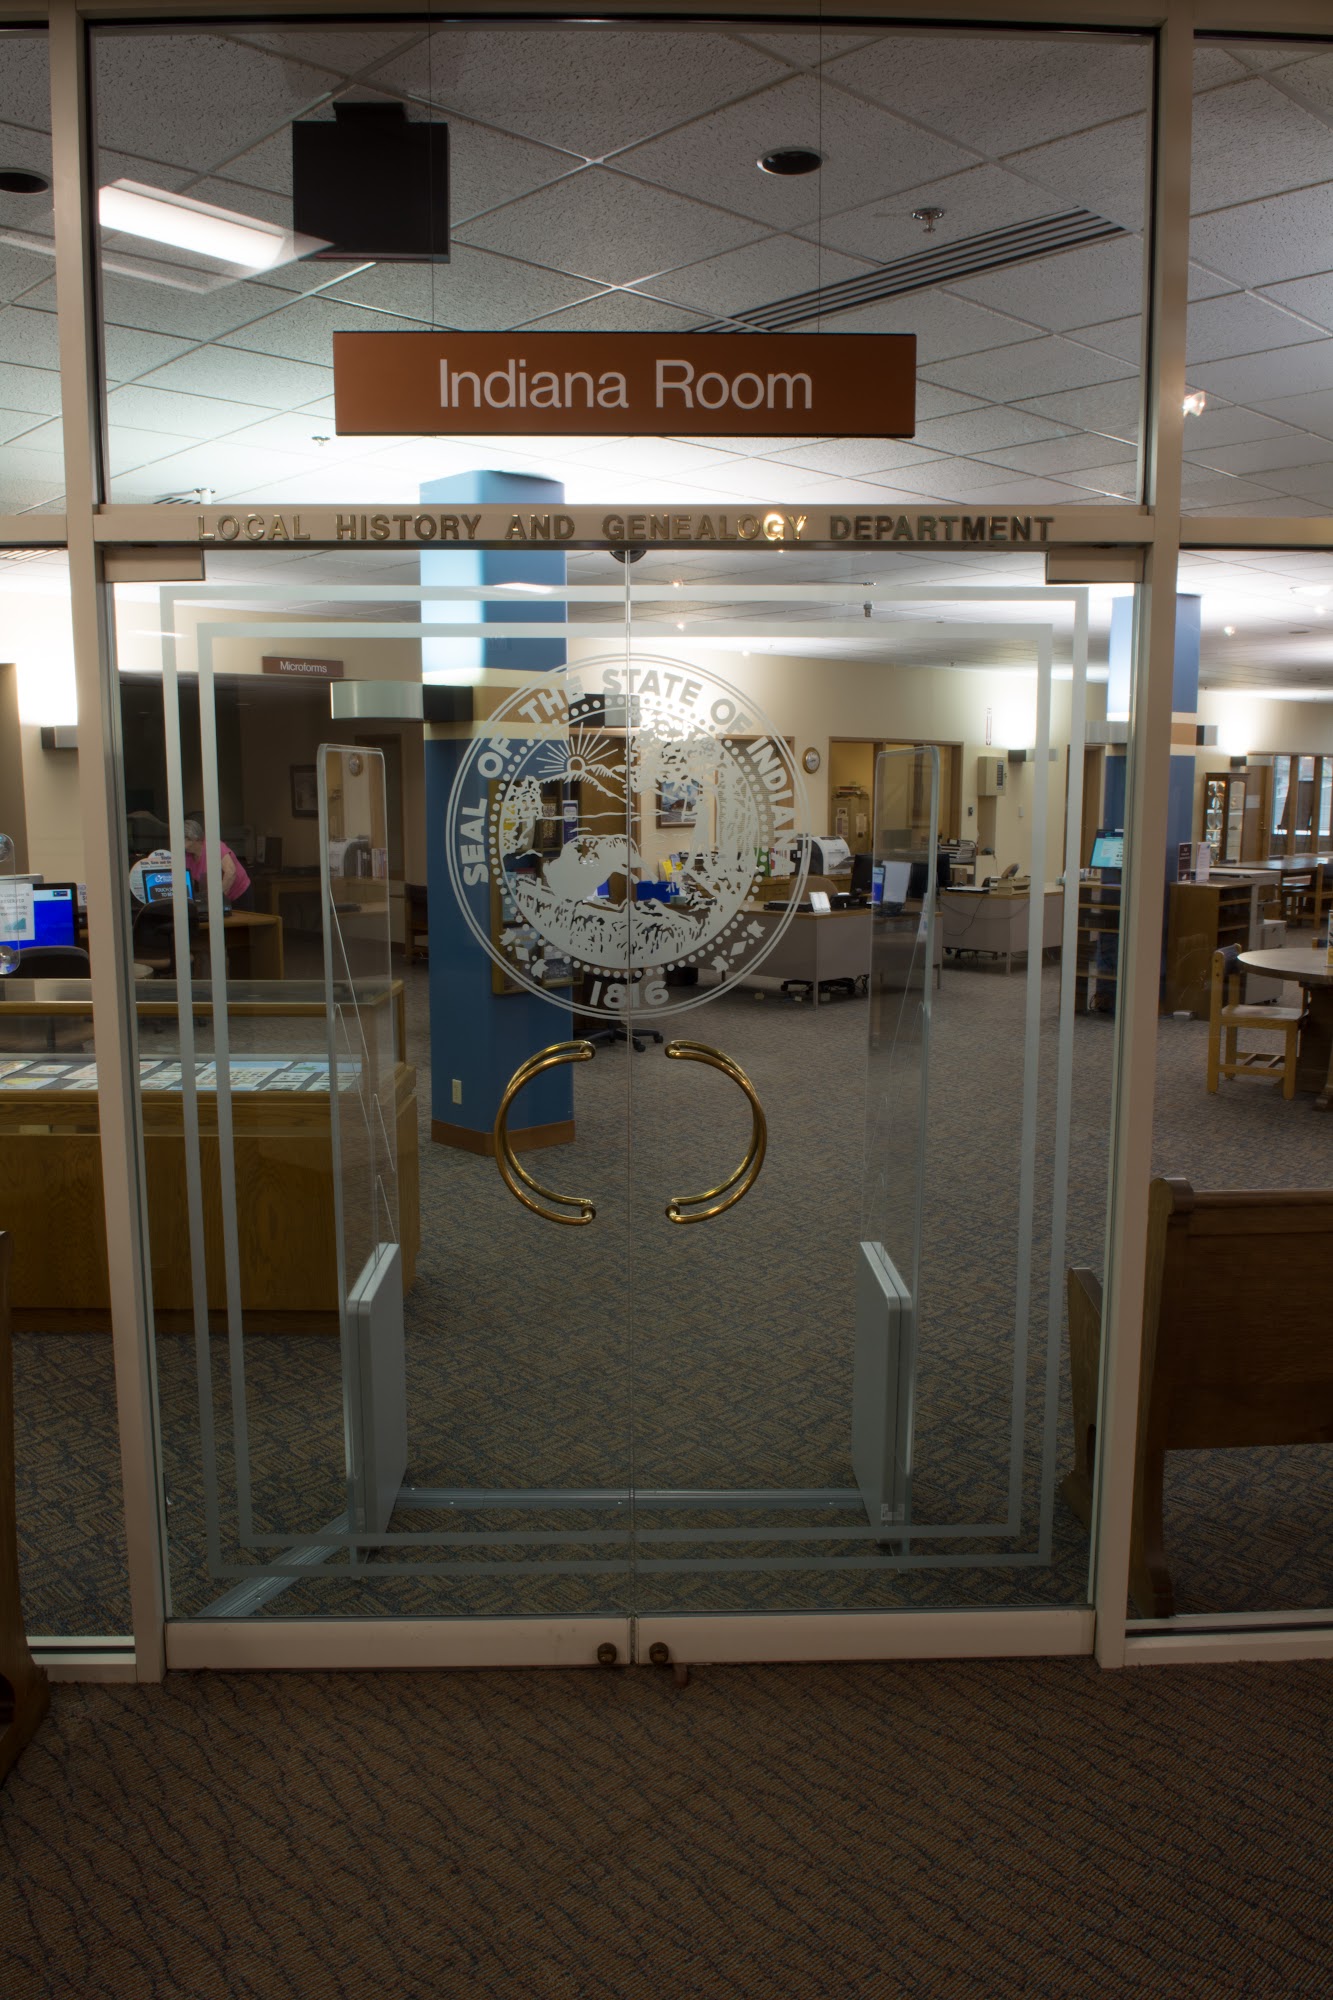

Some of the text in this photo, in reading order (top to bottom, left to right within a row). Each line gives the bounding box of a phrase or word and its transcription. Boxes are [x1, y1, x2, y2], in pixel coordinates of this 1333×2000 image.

[439, 358, 813, 410] Indiana Room
[198, 513, 1055, 542] LOCAL HISTORY AND GENEALOGY DEPARTMENT
[280, 660, 328, 673] Microforms
[460, 668, 798, 887] SEAL OF THE STATE OF INDIANA
[589, 980, 670, 1010] 1816
